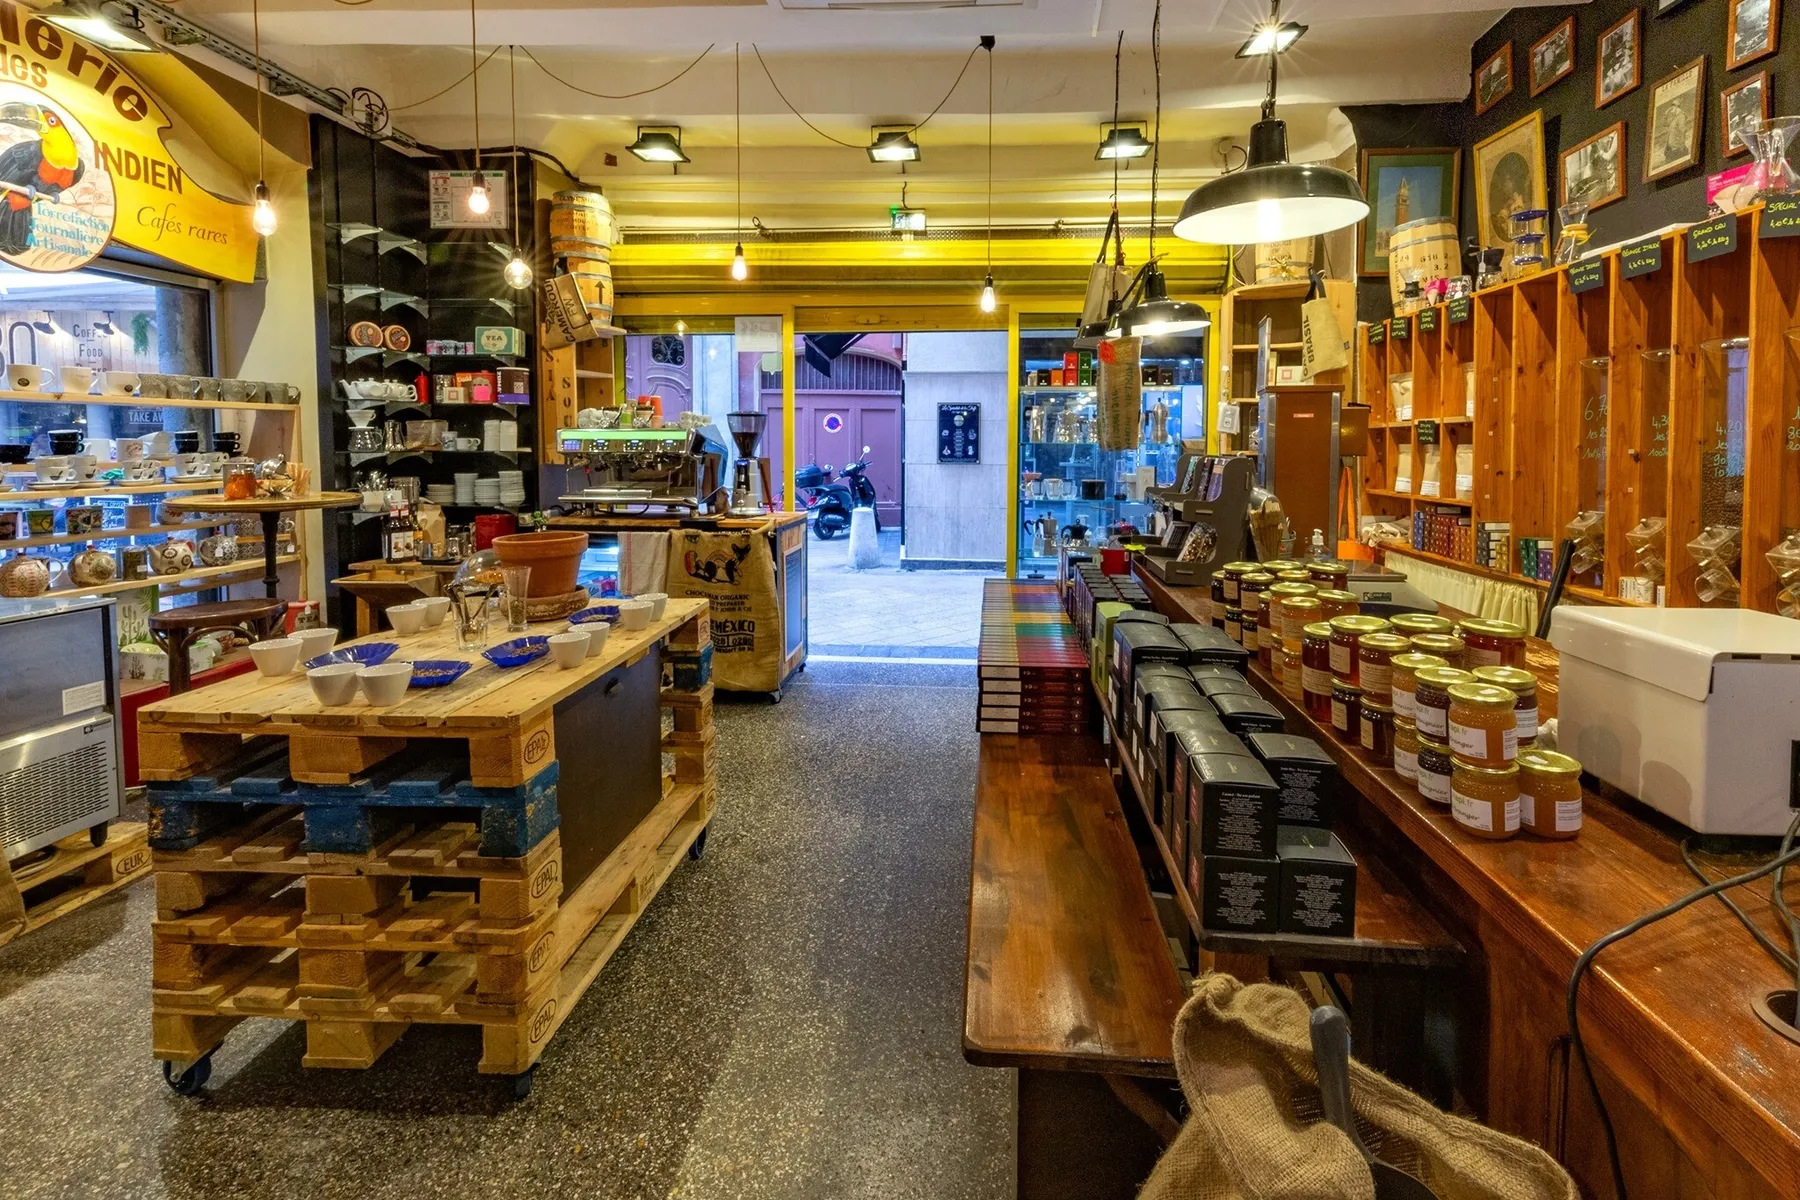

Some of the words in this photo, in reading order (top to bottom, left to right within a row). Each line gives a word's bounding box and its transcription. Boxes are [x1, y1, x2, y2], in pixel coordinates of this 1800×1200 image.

[94, 139, 183, 195] INDIEN
[137, 203, 182, 242] Cafés
[188, 225, 229, 245] rares
[1303, 315, 1315, 363] BRASIL
[79, 343, 103, 358] FOOD
[129, 411, 150, 423] TAKE
[1651, 414, 1669, 430] 4,3
[1715, 419, 1743, 435] 4,20
[298, 614, 319, 624] TEA
[715, 618, 755, 633] MÉXICO
[123, 851, 145, 872] EUR
[535, 863, 555, 898] EPAL
[533, 1005, 554, 1039] EPAL
